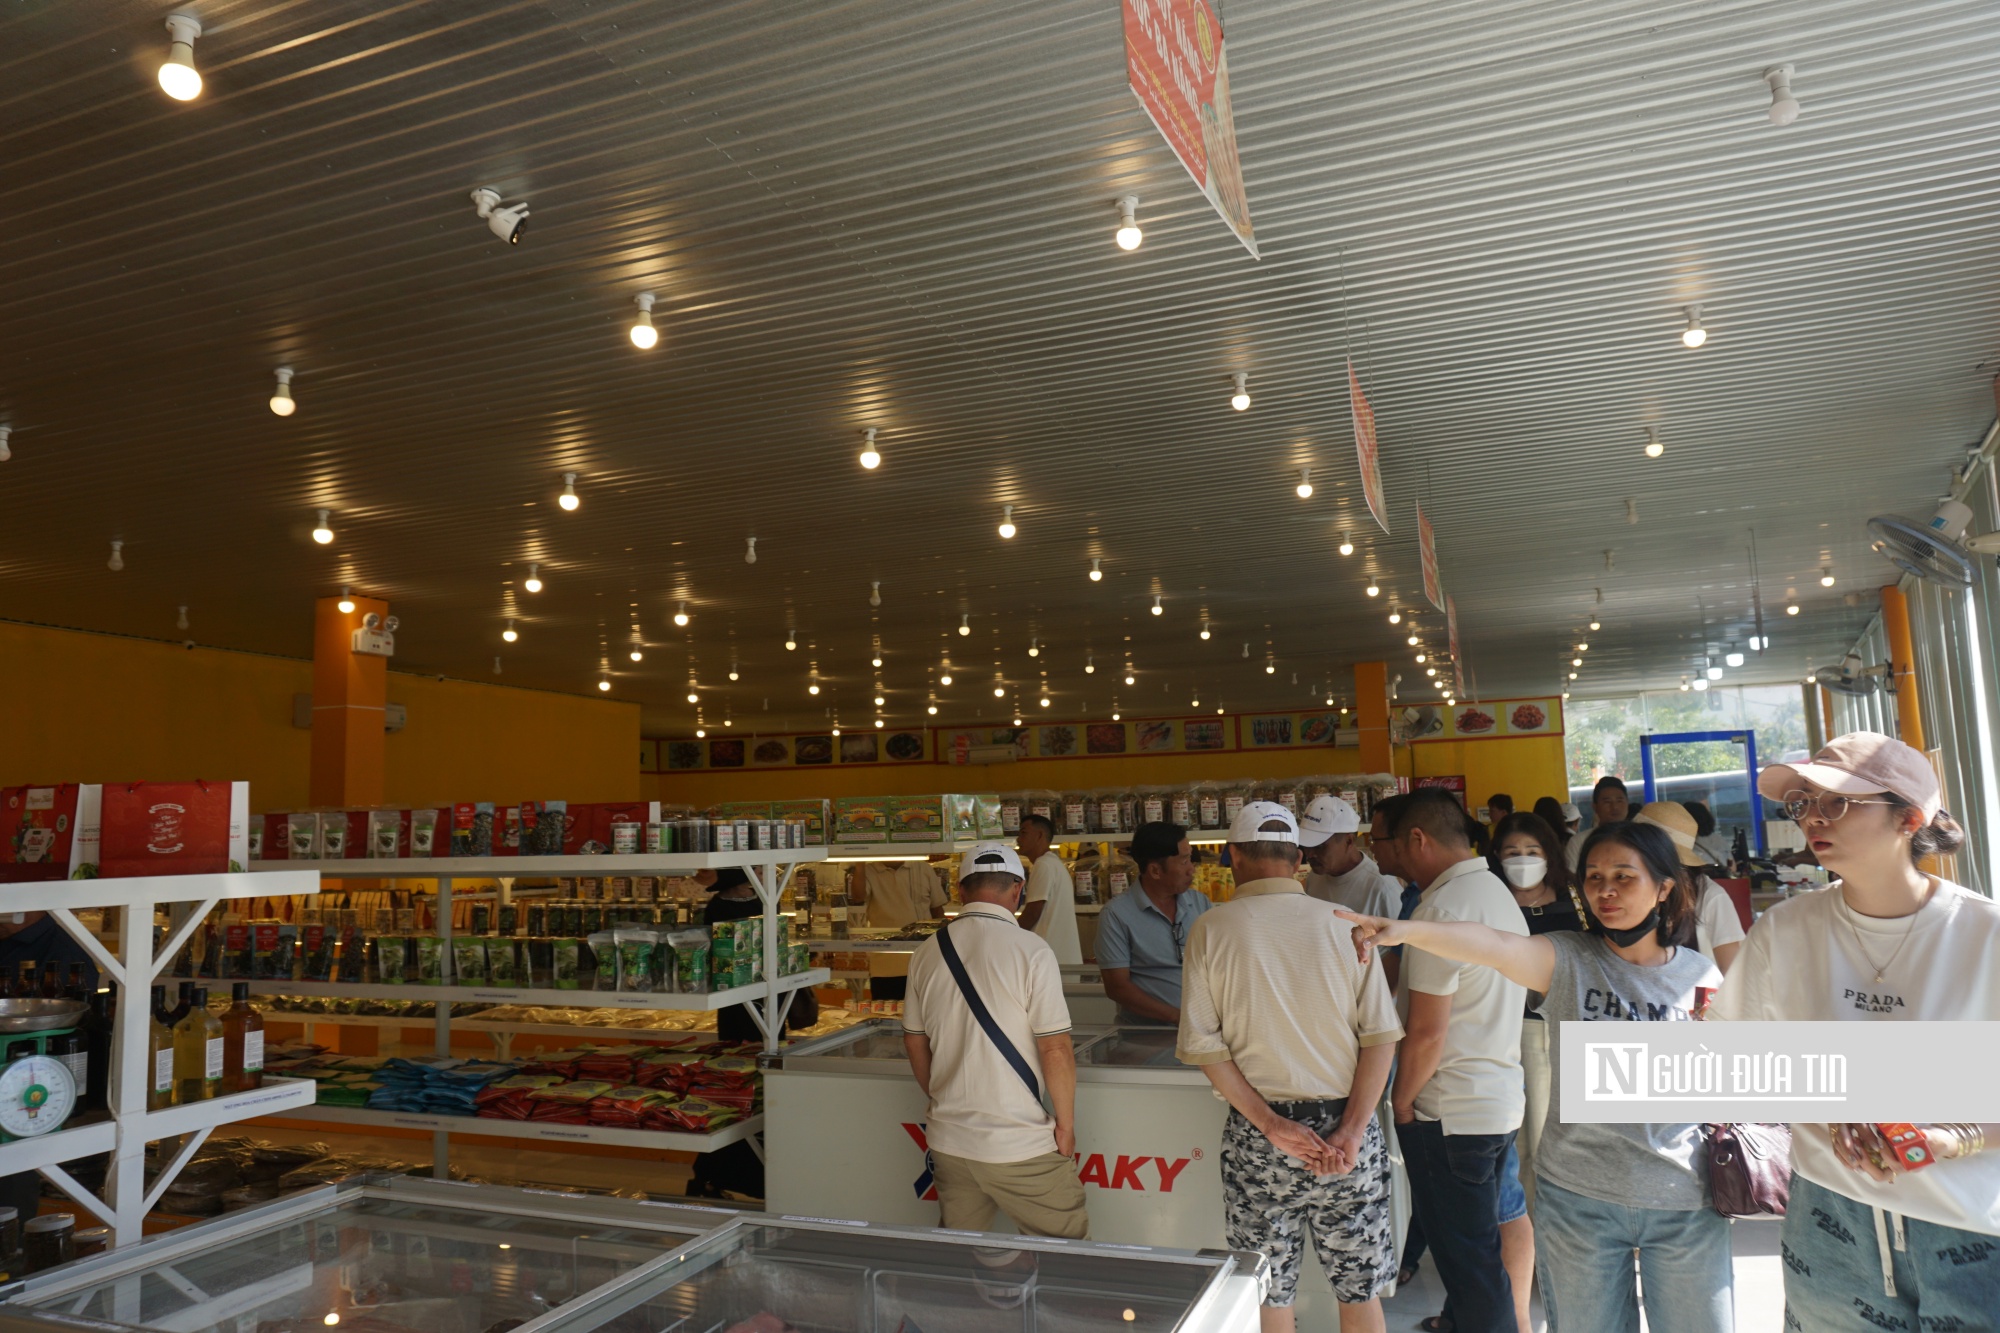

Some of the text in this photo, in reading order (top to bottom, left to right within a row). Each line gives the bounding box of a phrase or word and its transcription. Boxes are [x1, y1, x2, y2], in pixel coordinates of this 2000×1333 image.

[1174, 11, 1203, 85] NẮNG
[1153, 17, 1171, 74] BA
[1171, 49, 1201, 122] NẮNG
[1843, 988, 1905, 1007] PRADA
[1854, 1002, 1892, 1013] MILANO
[1810, 1207, 1857, 1246] PRADA
[1937, 1240, 1997, 1260] PRADA
[1853, 1297, 1908, 1330] PRADA
